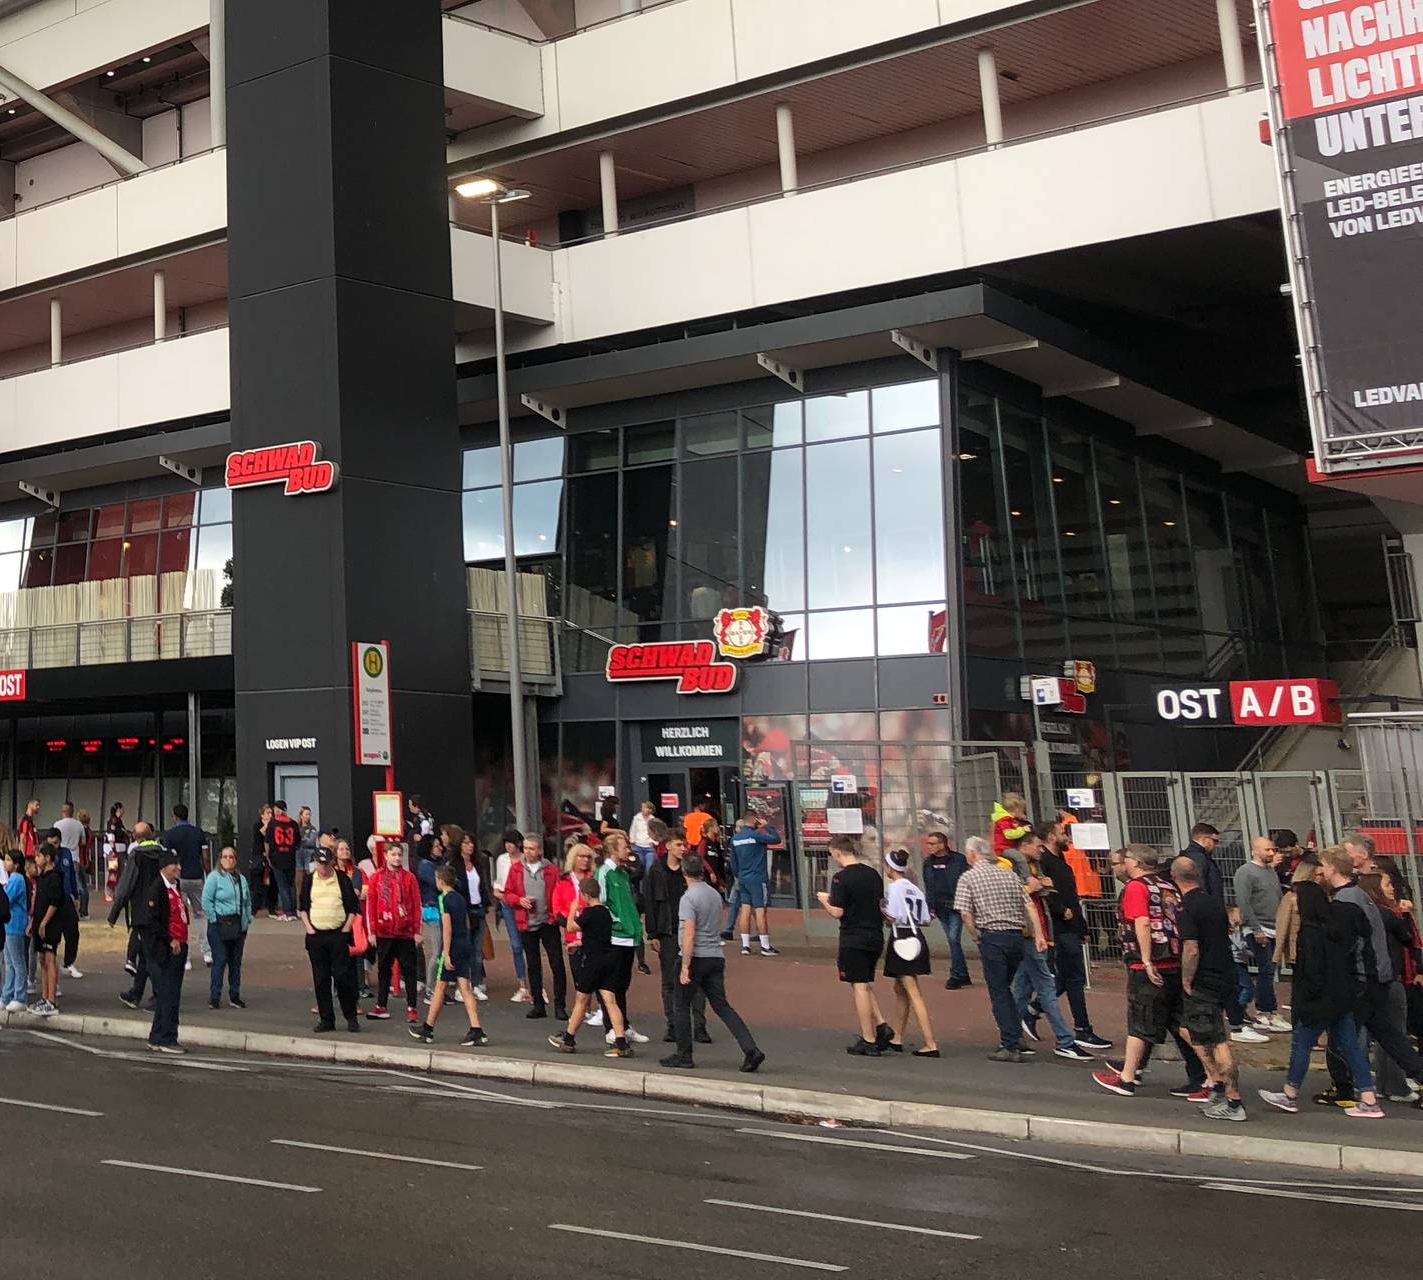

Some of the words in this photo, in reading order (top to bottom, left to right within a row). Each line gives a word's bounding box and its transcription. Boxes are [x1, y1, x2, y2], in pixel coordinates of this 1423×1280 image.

[1329, 215, 1373, 238] VON
[1353, 382, 1423, 408] LEDVA
[228, 442, 314, 478] SCHWAD
[287, 463, 332, 492] BUD
[369, 654, 377, 672] H
[610, 643, 713, 669] SCHWAD
[680, 666, 734, 690] BUD
[1157, 688, 1221, 720] OST
[1239, 685, 1316, 718] A/B
[289, 738, 302, 749] VIP
[302, 737, 317, 749] OST
[661, 726, 710, 739] HERZLICH
[654, 744, 723, 757] WILLKOMMEN
[274, 826, 294, 846] 63
